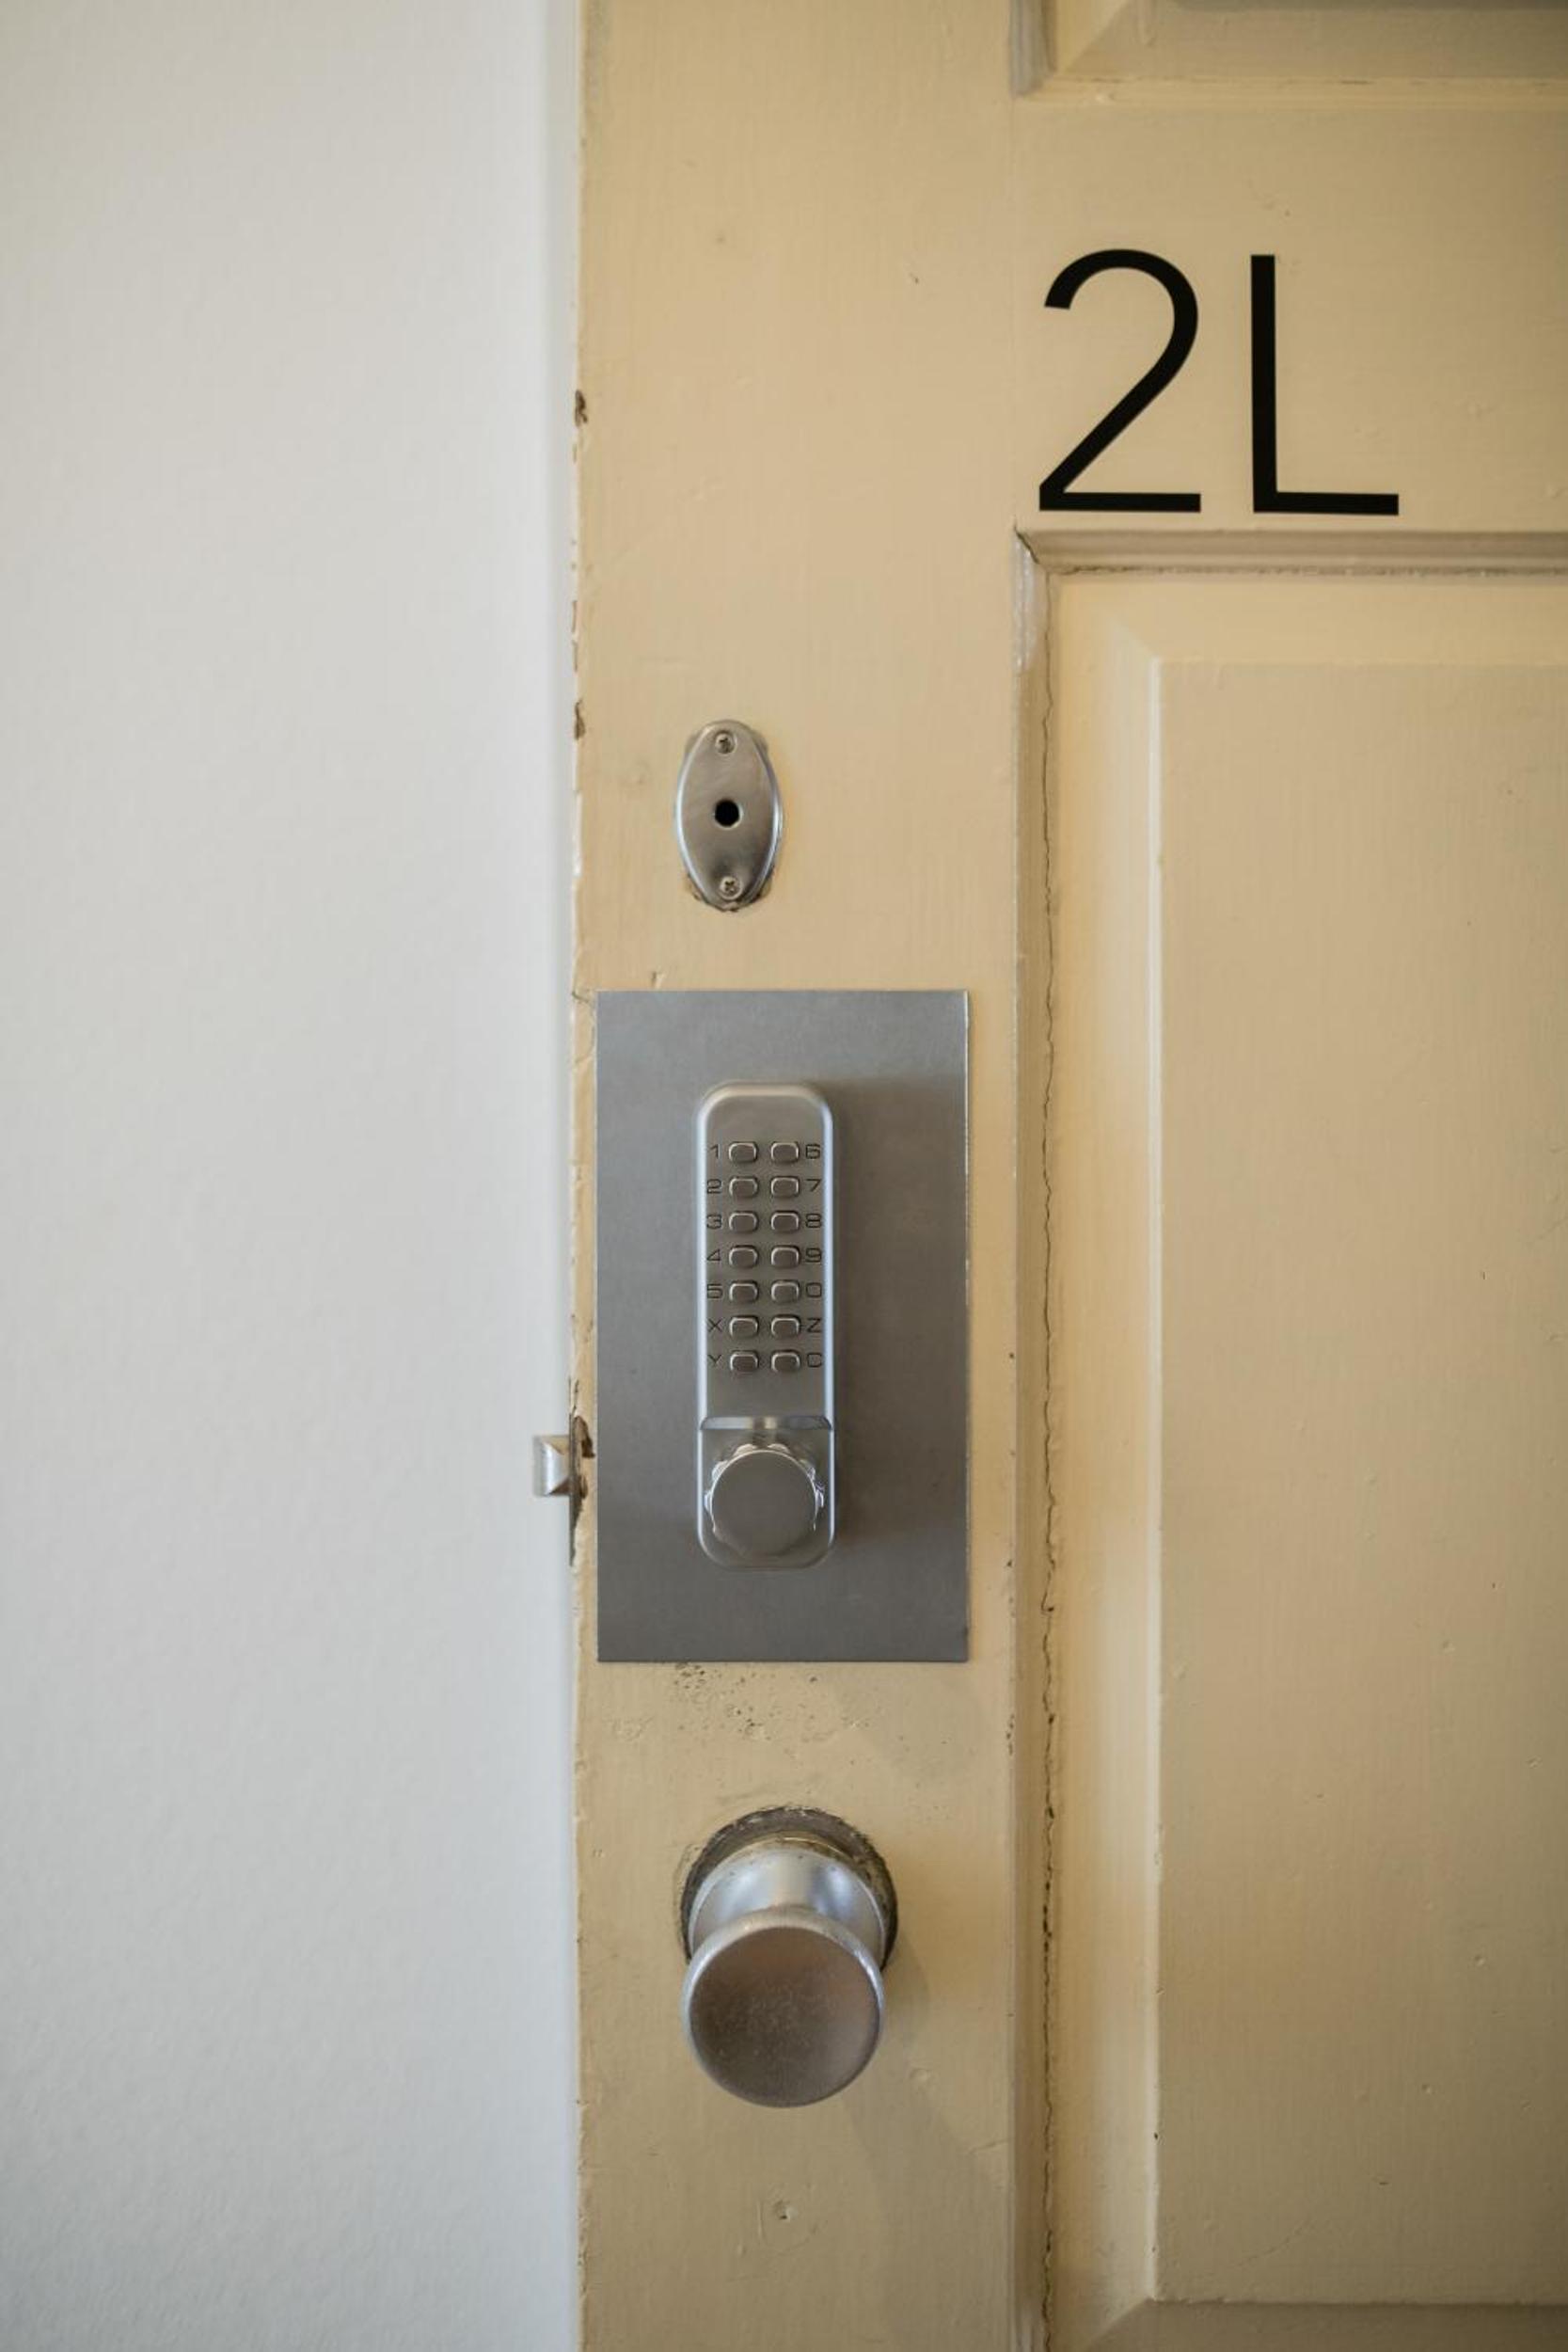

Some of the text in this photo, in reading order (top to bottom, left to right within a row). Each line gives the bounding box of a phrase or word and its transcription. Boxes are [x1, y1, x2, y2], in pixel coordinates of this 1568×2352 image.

[1038, 248, 1399, 516] 2L
[709, 1143, 720, 1159] 1
[805, 1143, 821, 1159] 6
[706, 1178, 722, 1194] 2
[806, 1178, 822, 1193] 7
[706, 1214, 722, 1230] 3
[805, 1213, 822, 1229] 8
[706, 1248, 721, 1263] 4
[805, 1248, 822, 1263] 9
[706, 1283, 722, 1299] 5
[707, 1317, 722, 1333] X
[806, 1317, 822, 1333] Z
[707, 1354, 722, 1369] Y
